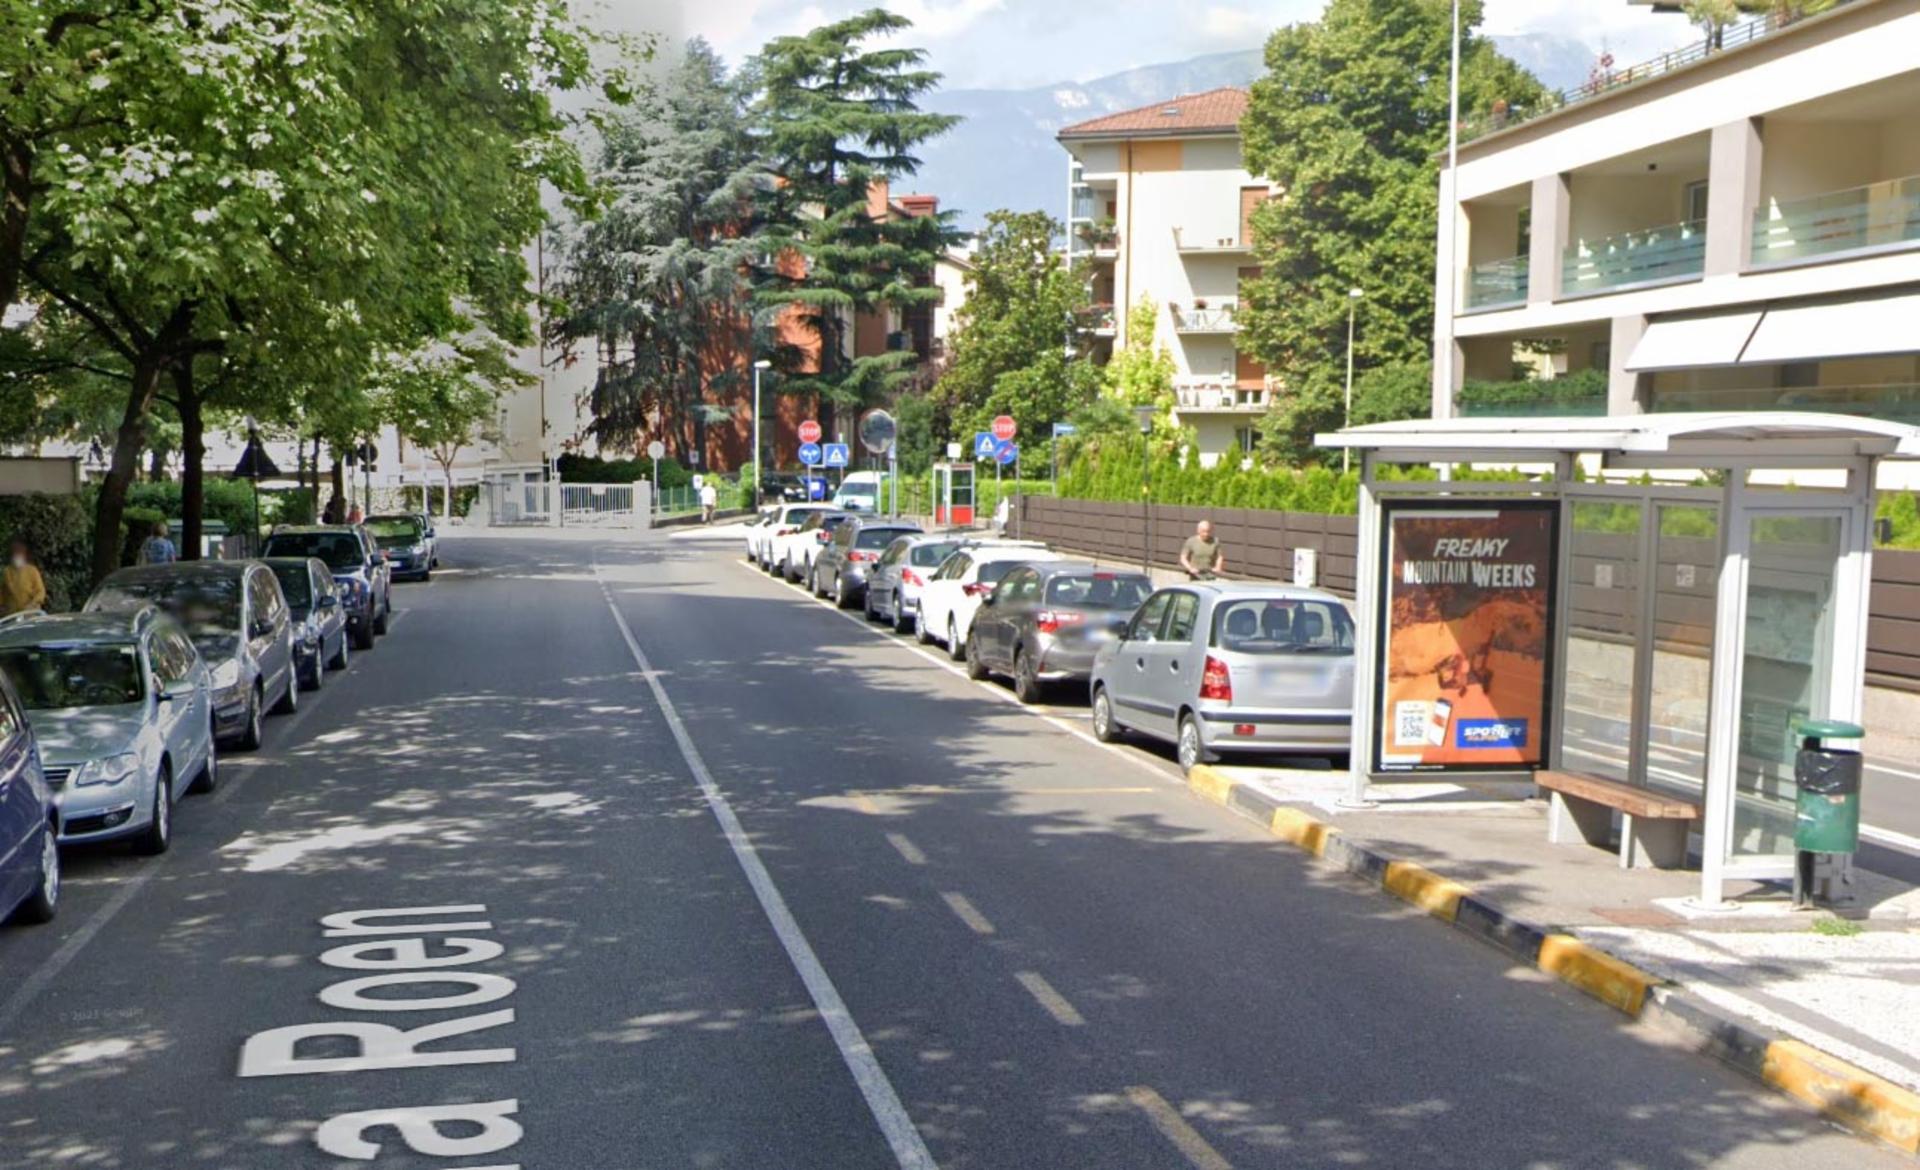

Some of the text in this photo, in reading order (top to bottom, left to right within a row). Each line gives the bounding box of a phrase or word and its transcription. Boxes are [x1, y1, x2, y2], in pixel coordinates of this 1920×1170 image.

[1433, 538, 1509, 557] FREAKY
[1403, 560, 1536, 588] MOUNTAIN WEEKS
[237, 904, 517, 1077] Roen
